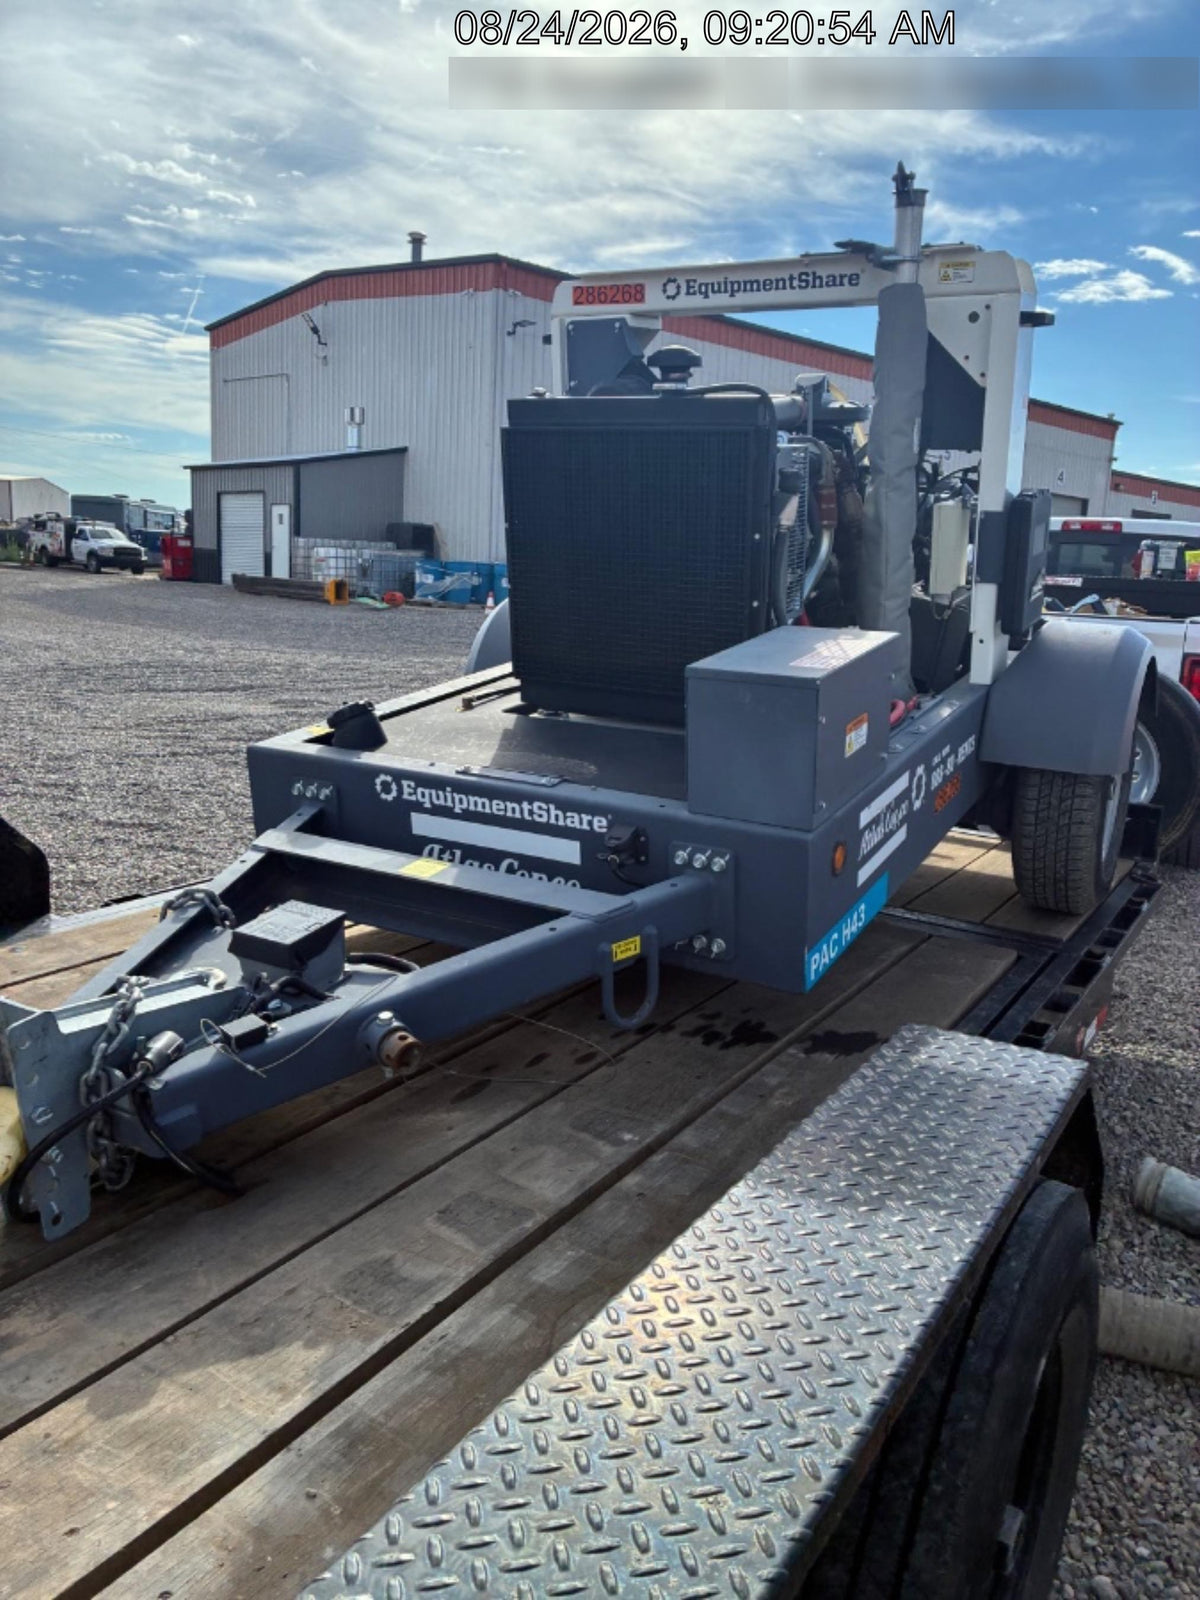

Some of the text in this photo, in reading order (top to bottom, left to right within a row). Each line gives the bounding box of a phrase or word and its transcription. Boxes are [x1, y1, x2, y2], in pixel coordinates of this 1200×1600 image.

[573, 283, 645, 305] 286268
[685, 271, 861, 299] EquipmentShare
[401, 779, 608, 833] EquipmentShare
[810, 902, 866, 981] PAC H43
